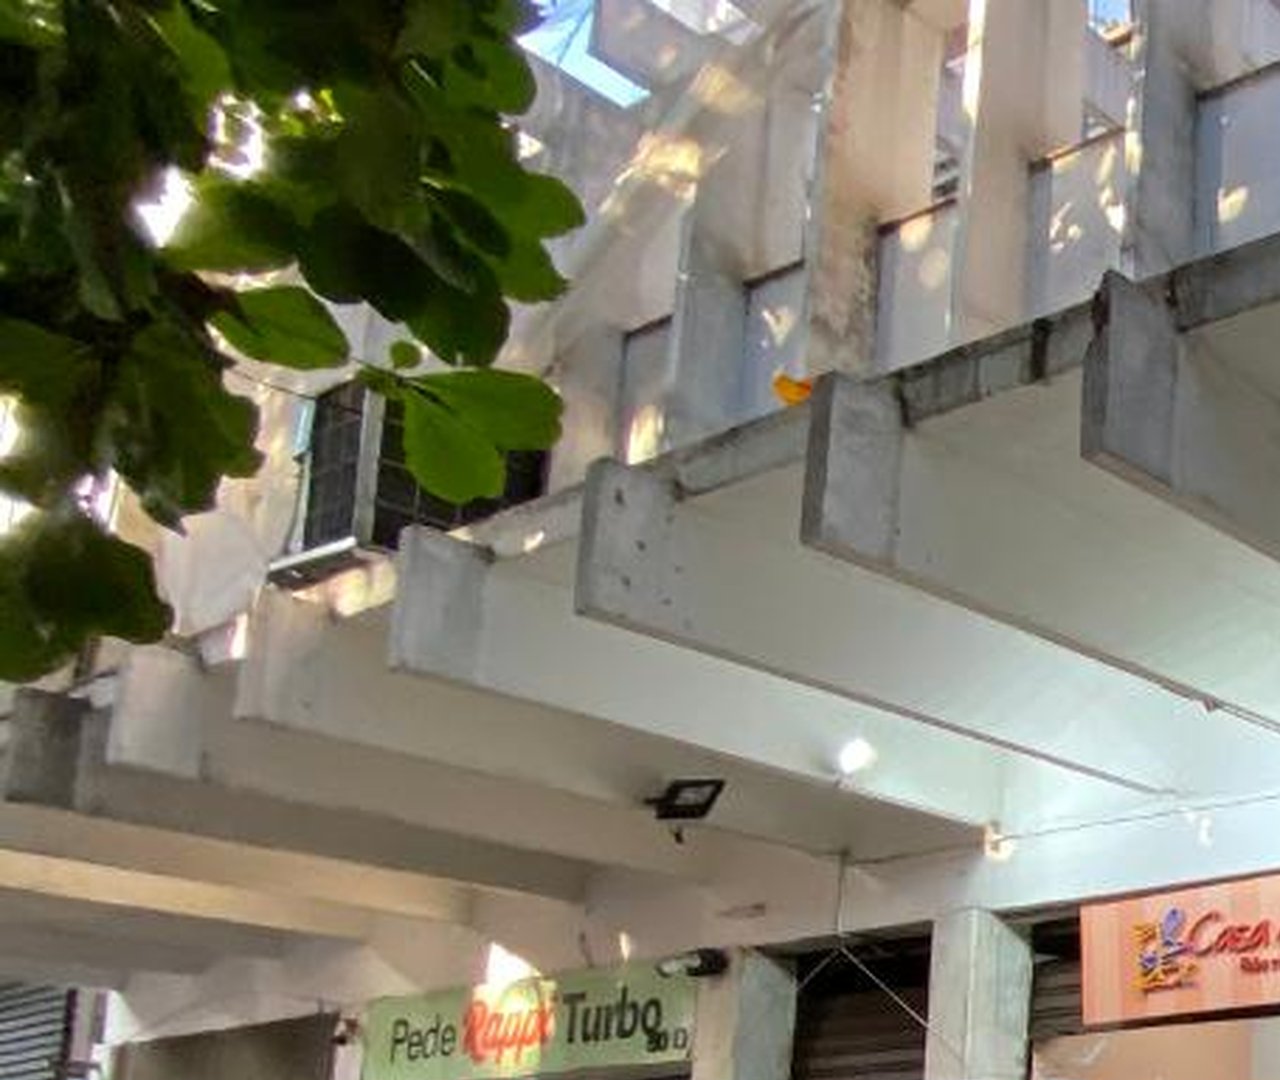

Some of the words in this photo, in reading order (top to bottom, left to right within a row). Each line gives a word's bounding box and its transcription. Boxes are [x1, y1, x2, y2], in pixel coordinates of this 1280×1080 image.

[1187, 911, 1271, 957] Casa
[389, 1015, 457, 1063] Pede
[562, 986, 662, 1043] Turbo
